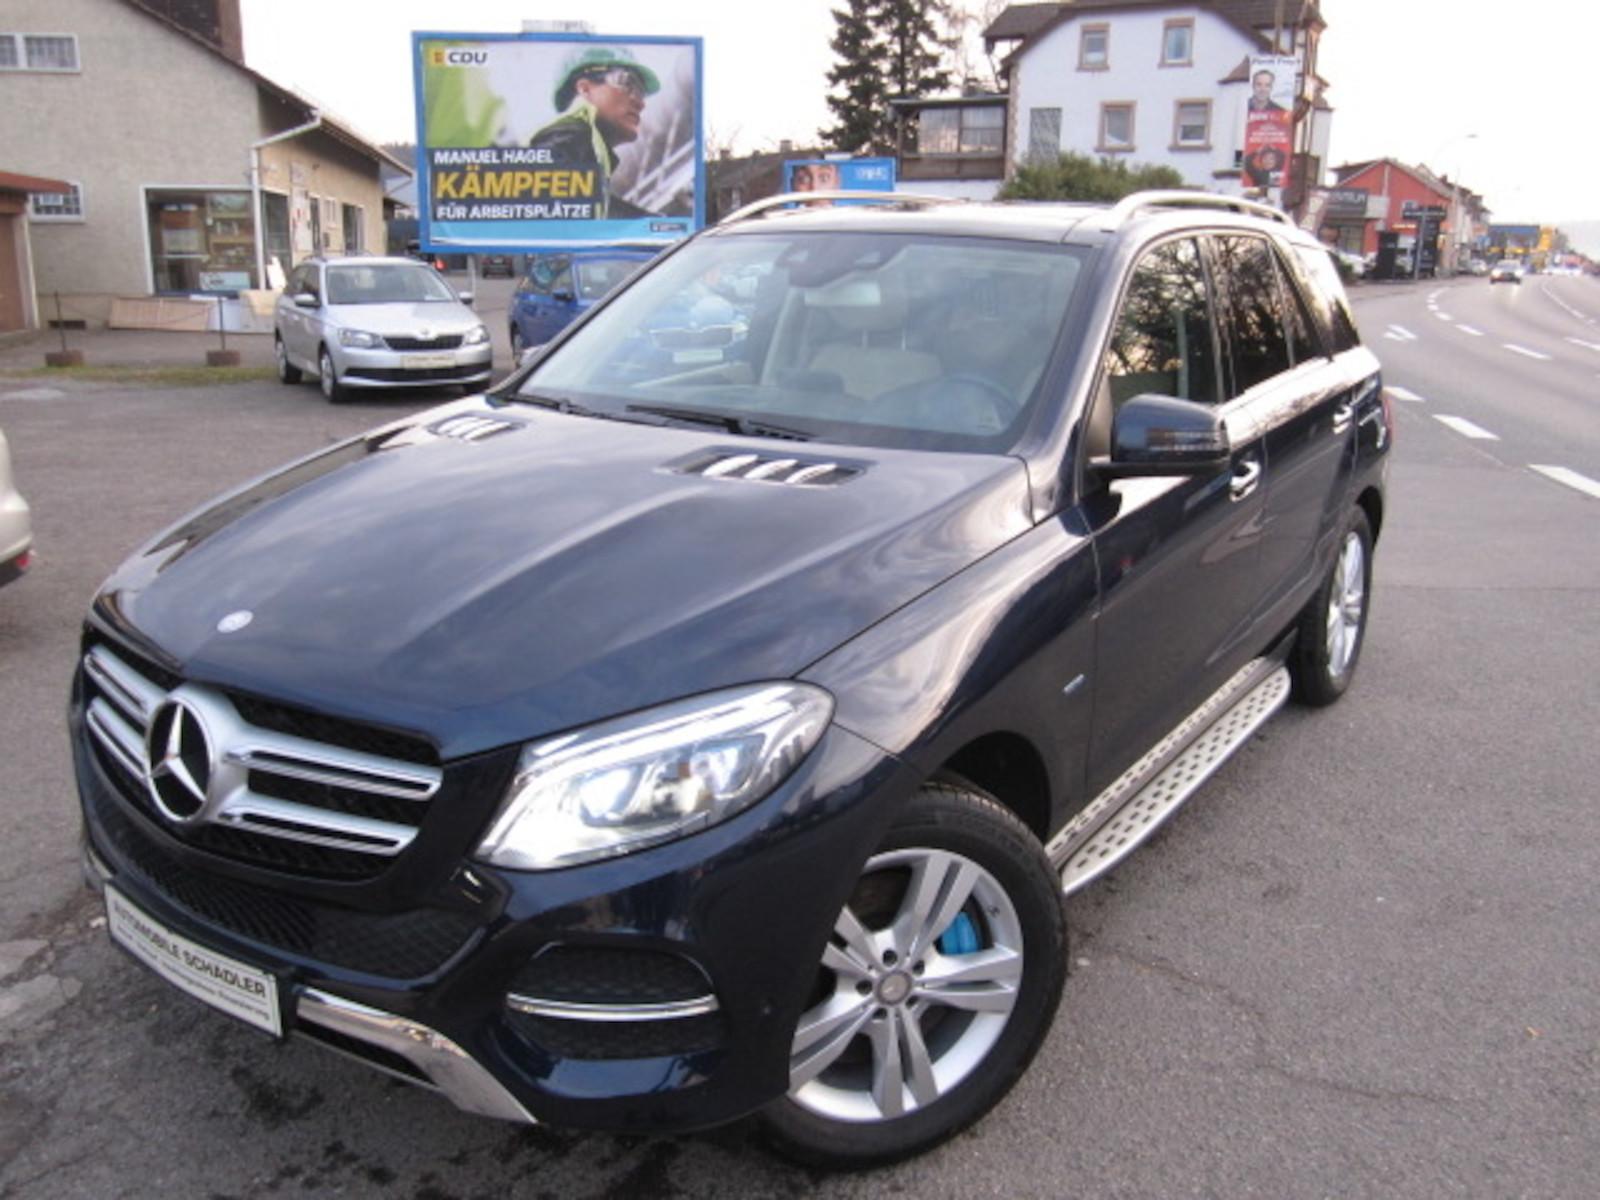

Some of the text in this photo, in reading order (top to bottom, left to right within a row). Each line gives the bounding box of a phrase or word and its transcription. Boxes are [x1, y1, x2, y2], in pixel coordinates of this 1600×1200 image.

[449, 51, 488, 64] CDU
[434, 149, 500, 165] MANUEL
[436, 165, 594, 199] KÄMPFEN
[436, 201, 591, 219] FÜR ARBEITSPLÄTZE
